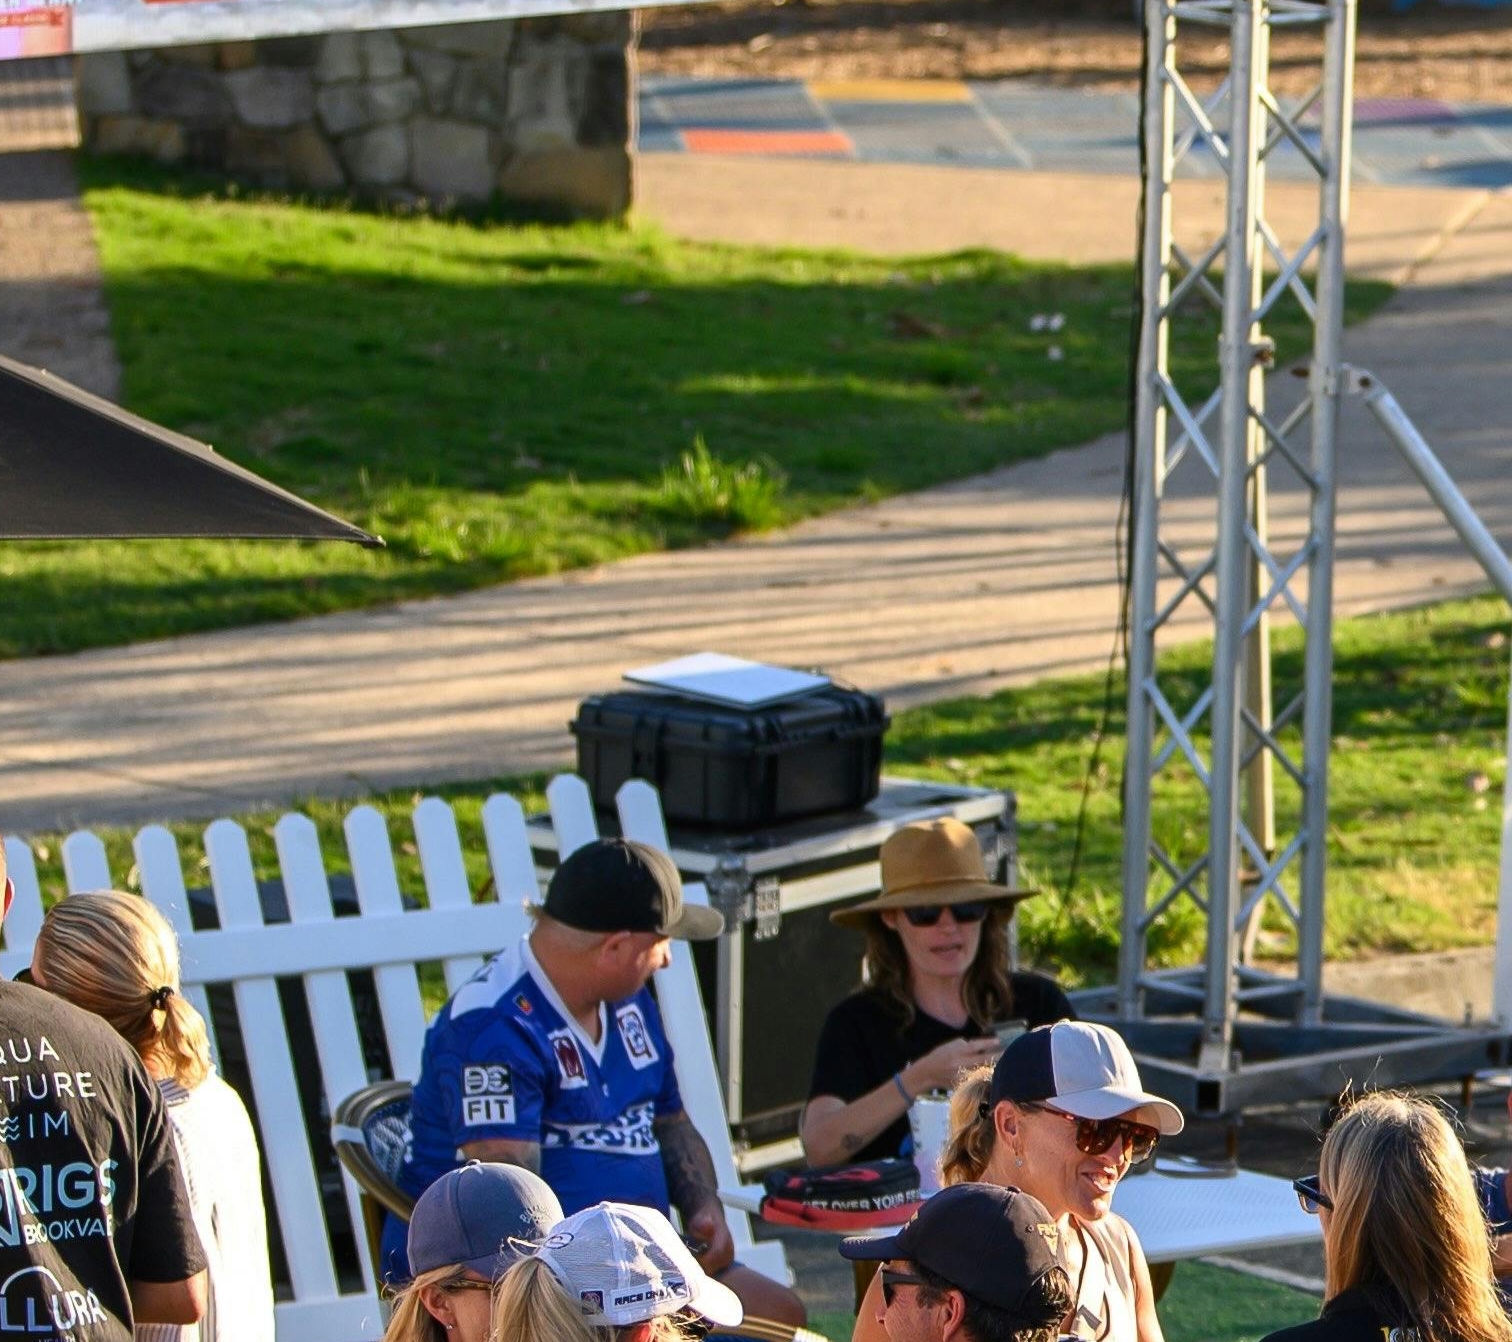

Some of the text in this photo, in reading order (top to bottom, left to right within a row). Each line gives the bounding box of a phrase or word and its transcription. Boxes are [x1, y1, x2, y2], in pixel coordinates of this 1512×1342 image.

[468, 1098, 509, 1121] FIT
[7, 1159, 119, 1216] RIGS
[872, 1192, 904, 1210] YOUR
[614, 1293, 644, 1306] RACE
